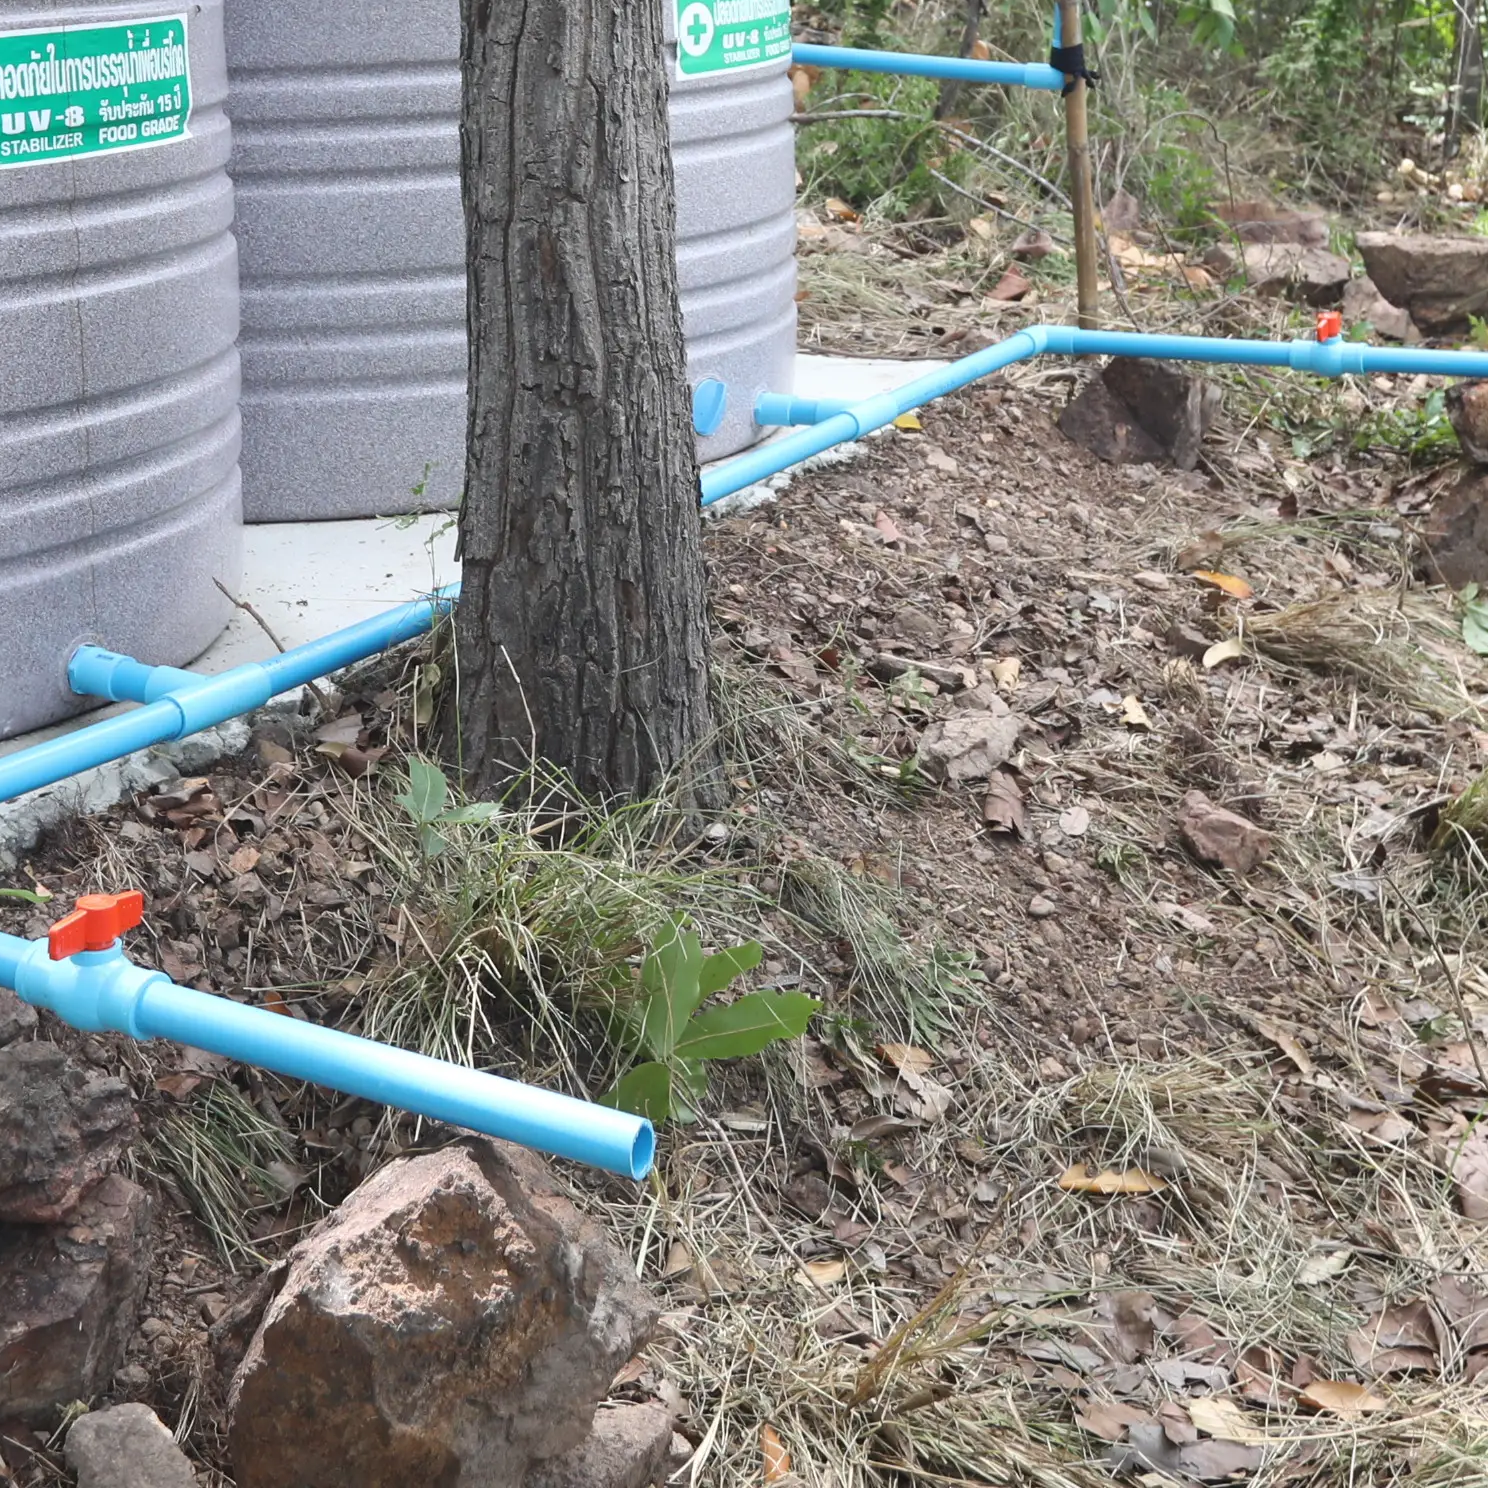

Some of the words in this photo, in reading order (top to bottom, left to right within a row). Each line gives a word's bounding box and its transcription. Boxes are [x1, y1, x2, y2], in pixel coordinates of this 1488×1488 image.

[722, 29, 759, 49] UV-8
[99, 94, 154, 121] รับประกัน
[157, 94, 172, 112] 15
[174, 84, 181, 109] ปี
[1, 106, 85, 135] UV-8
[99, 123, 137, 144] FOOD
[141, 115, 180, 137] GRADE
[1, 133, 83, 156] STABILIZER
